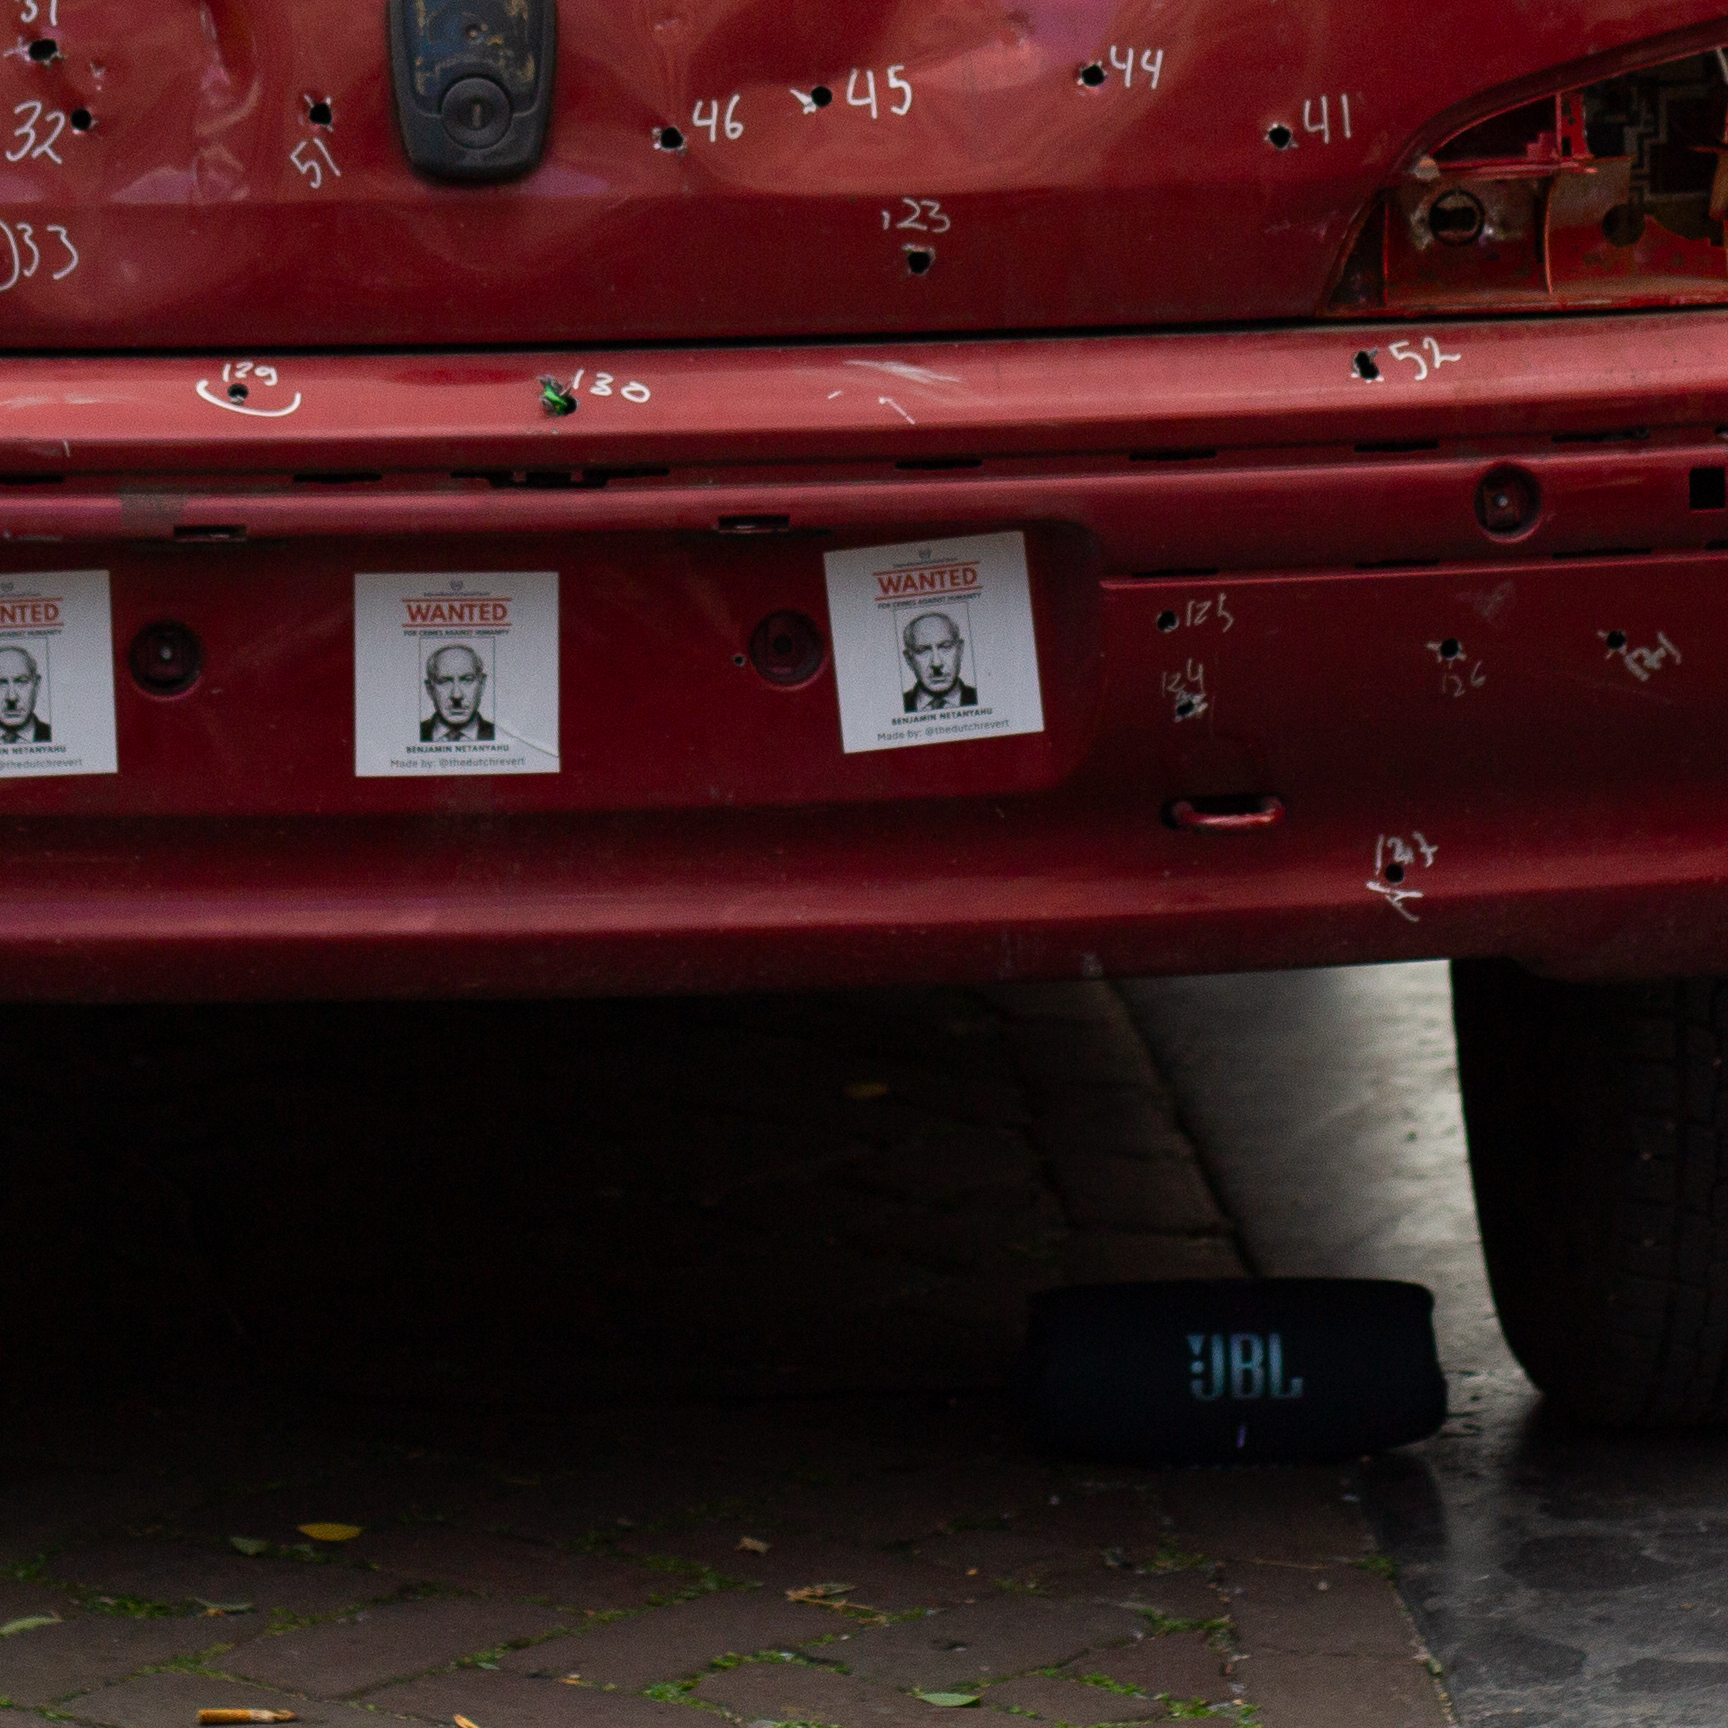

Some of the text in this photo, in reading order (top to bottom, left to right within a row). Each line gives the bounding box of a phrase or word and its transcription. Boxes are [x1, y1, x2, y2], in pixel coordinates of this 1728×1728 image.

[1109, 44, 1164, 90] 44
[845, 65, 914, 120] 45
[5, 100, 66, 165] 32
[692, 94, 745, 143] 46
[1302, 93, 1353, 145] 41
[290, 138, 341, 189] 51
[882, 198, 952, 234] 123
[17, 223, 79, 280] 33
[220, 360, 278, 388] 129
[1388, 334, 1462, 382] 52
[571, 368, 652, 406] 130
[877, 567, 978, 594] WANTED
[406, 603, 508, 622] WANTED
[1185, 593, 1234, 633] 125
[1163, 659, 1204, 698] 124
[1441, 661, 1486, 698] 126
[877, 732, 905, 741] Made
[892, 708, 993, 726] BENJAMIN NETANYAHU
[12, 745, 66, 754] NETANYAHU
[390, 759, 418, 768] Made
[406, 745, 509, 754] BENJAMIN NETANYAHU
[1375, 831, 1438, 875] 127
[1190, 1332, 1304, 1400] JBL
